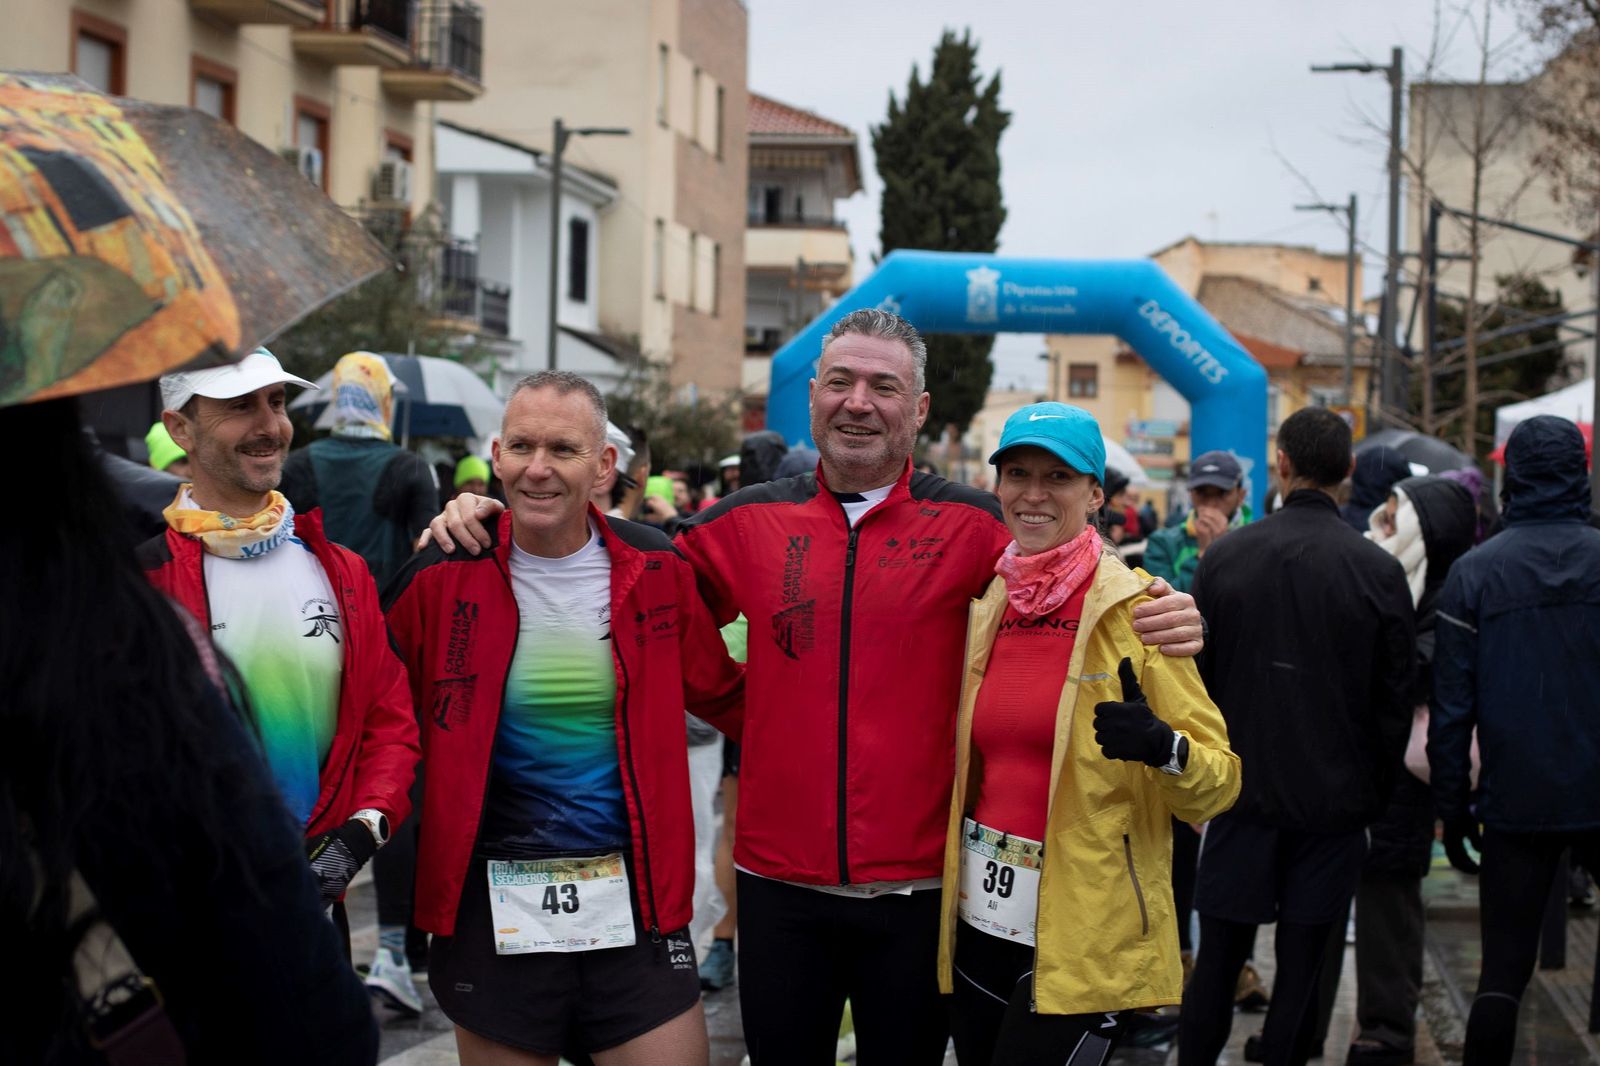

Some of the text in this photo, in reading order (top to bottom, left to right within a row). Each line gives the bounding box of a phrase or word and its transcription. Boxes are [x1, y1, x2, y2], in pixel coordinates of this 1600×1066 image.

[1138, 299, 1229, 384] DEPORTES
[783, 551, 794, 604] CARRERA
[790, 551, 803, 603] POPULAR
[445, 619, 462, 673] CARRERA
[453, 618, 472, 676] POPULAR
[494, 863, 519, 875] RUTA
[495, 872, 549, 886] SECADEROS
[983, 860, 1015, 898] 39
[542, 883, 580, 915] 43
[987, 900, 999, 911] Ali
